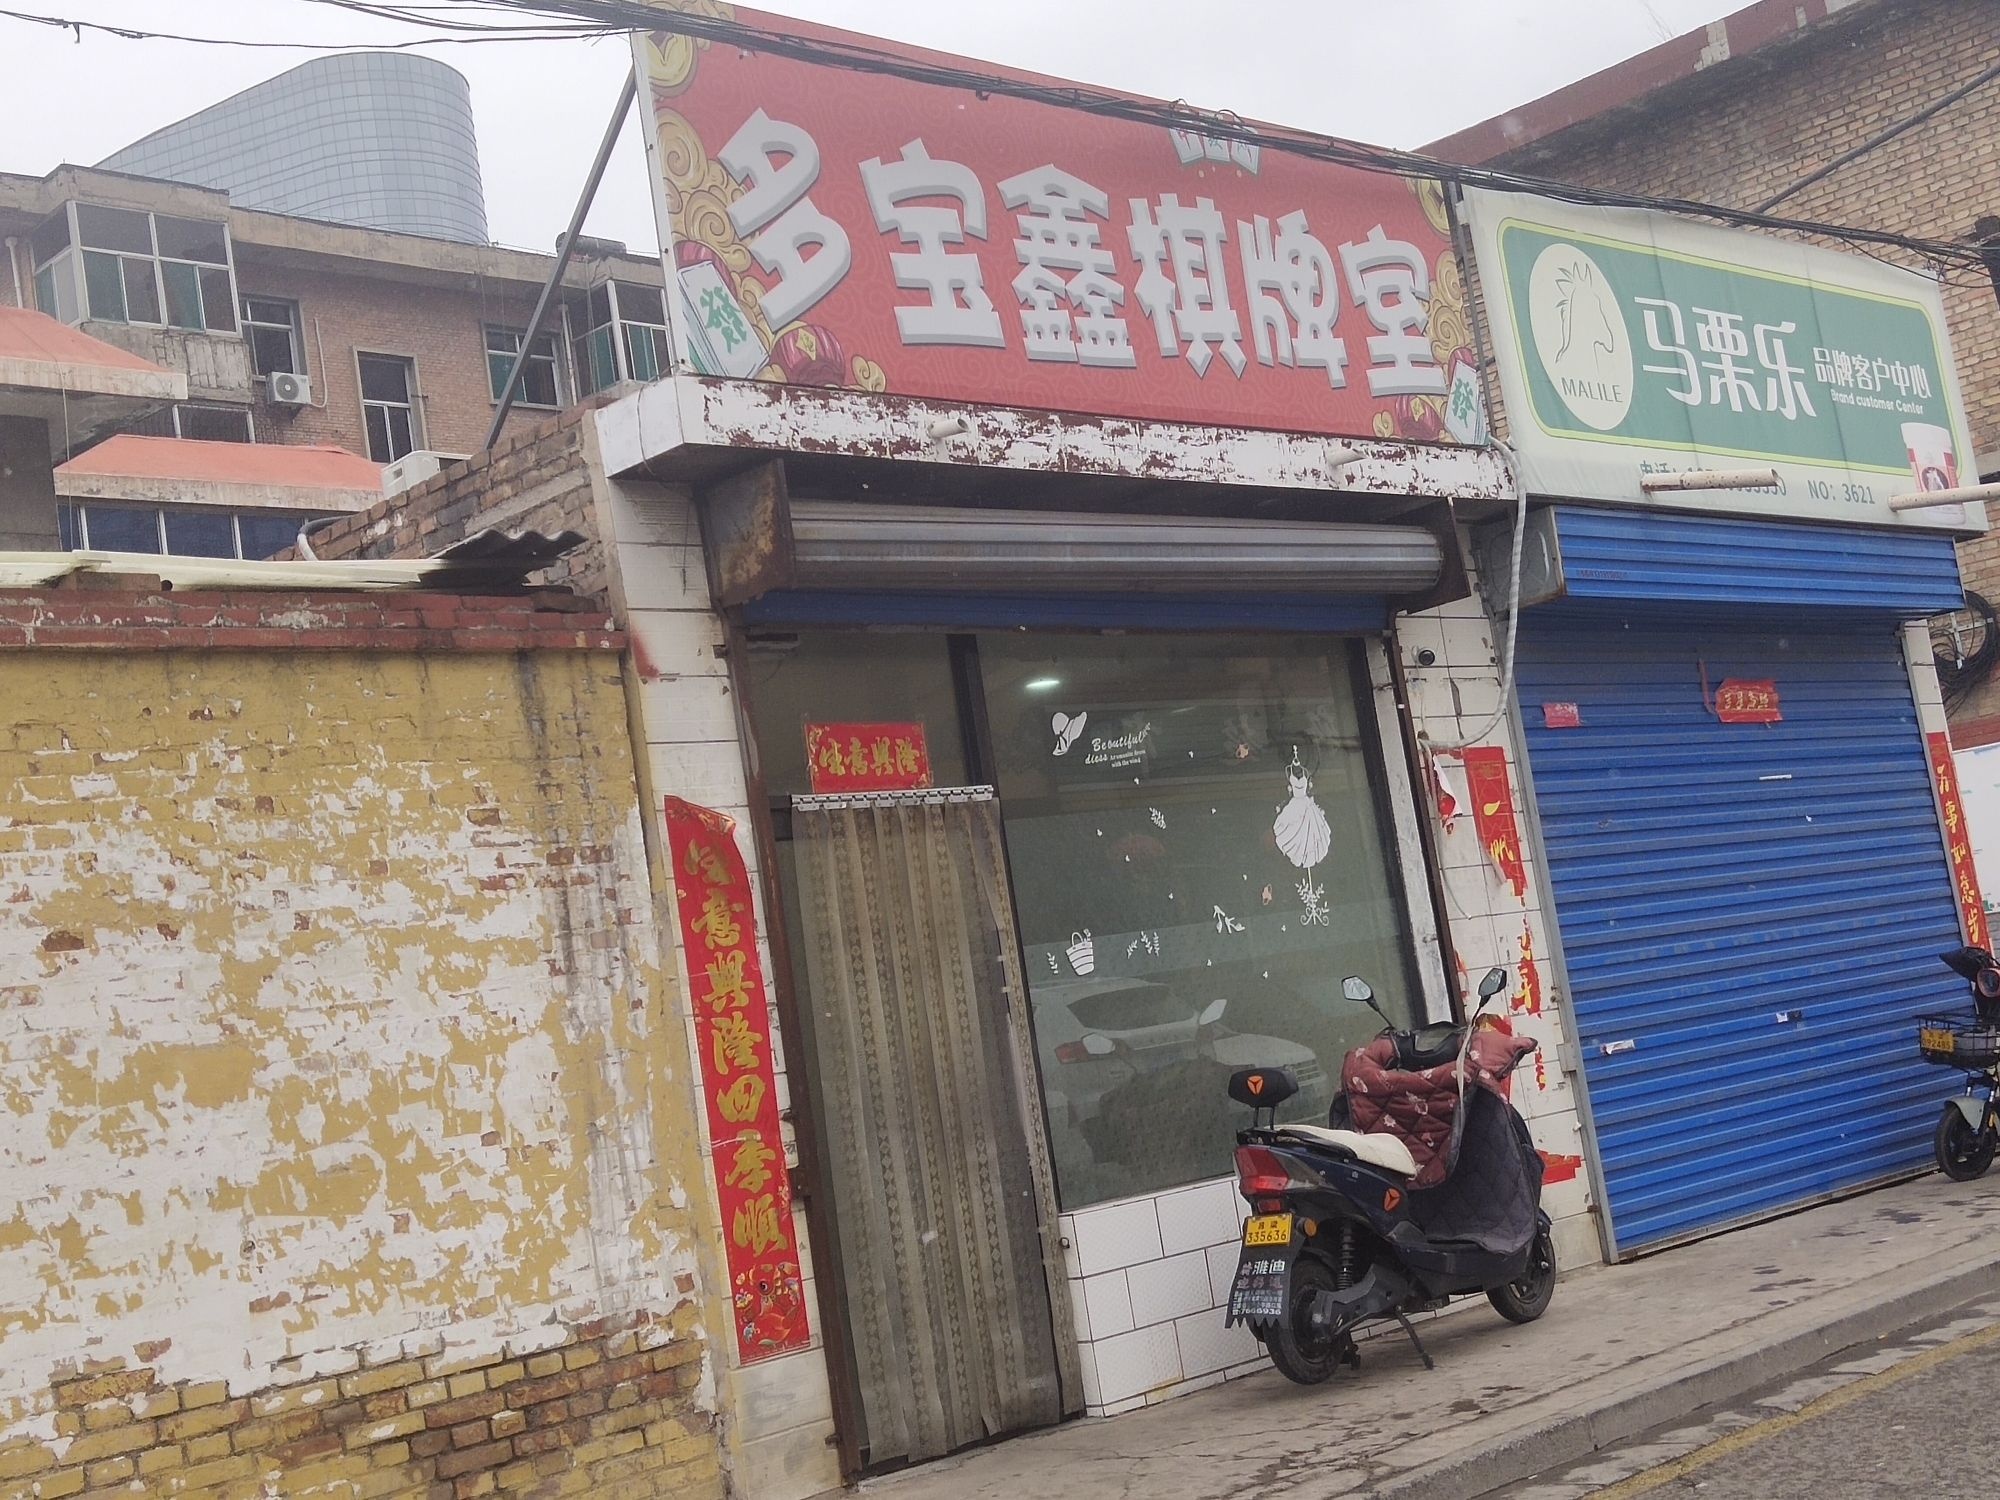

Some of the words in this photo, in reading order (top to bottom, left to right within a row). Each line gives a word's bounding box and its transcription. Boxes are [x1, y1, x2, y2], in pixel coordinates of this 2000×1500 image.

[716, 107, 1449, 399] 多宝鑫棋牌室
[1634, 296, 1816, 421] 马栗乐
[1812, 347, 1932, 399] 品牌客户中心
[1561, 377, 1624, 403] MALILE
[1856, 395, 1895, 411] customer
[1896, 400, 1924, 415] Center
[1841, 483, 1876, 505] 3621
[1247, 1229, 1287, 1243] 335636
